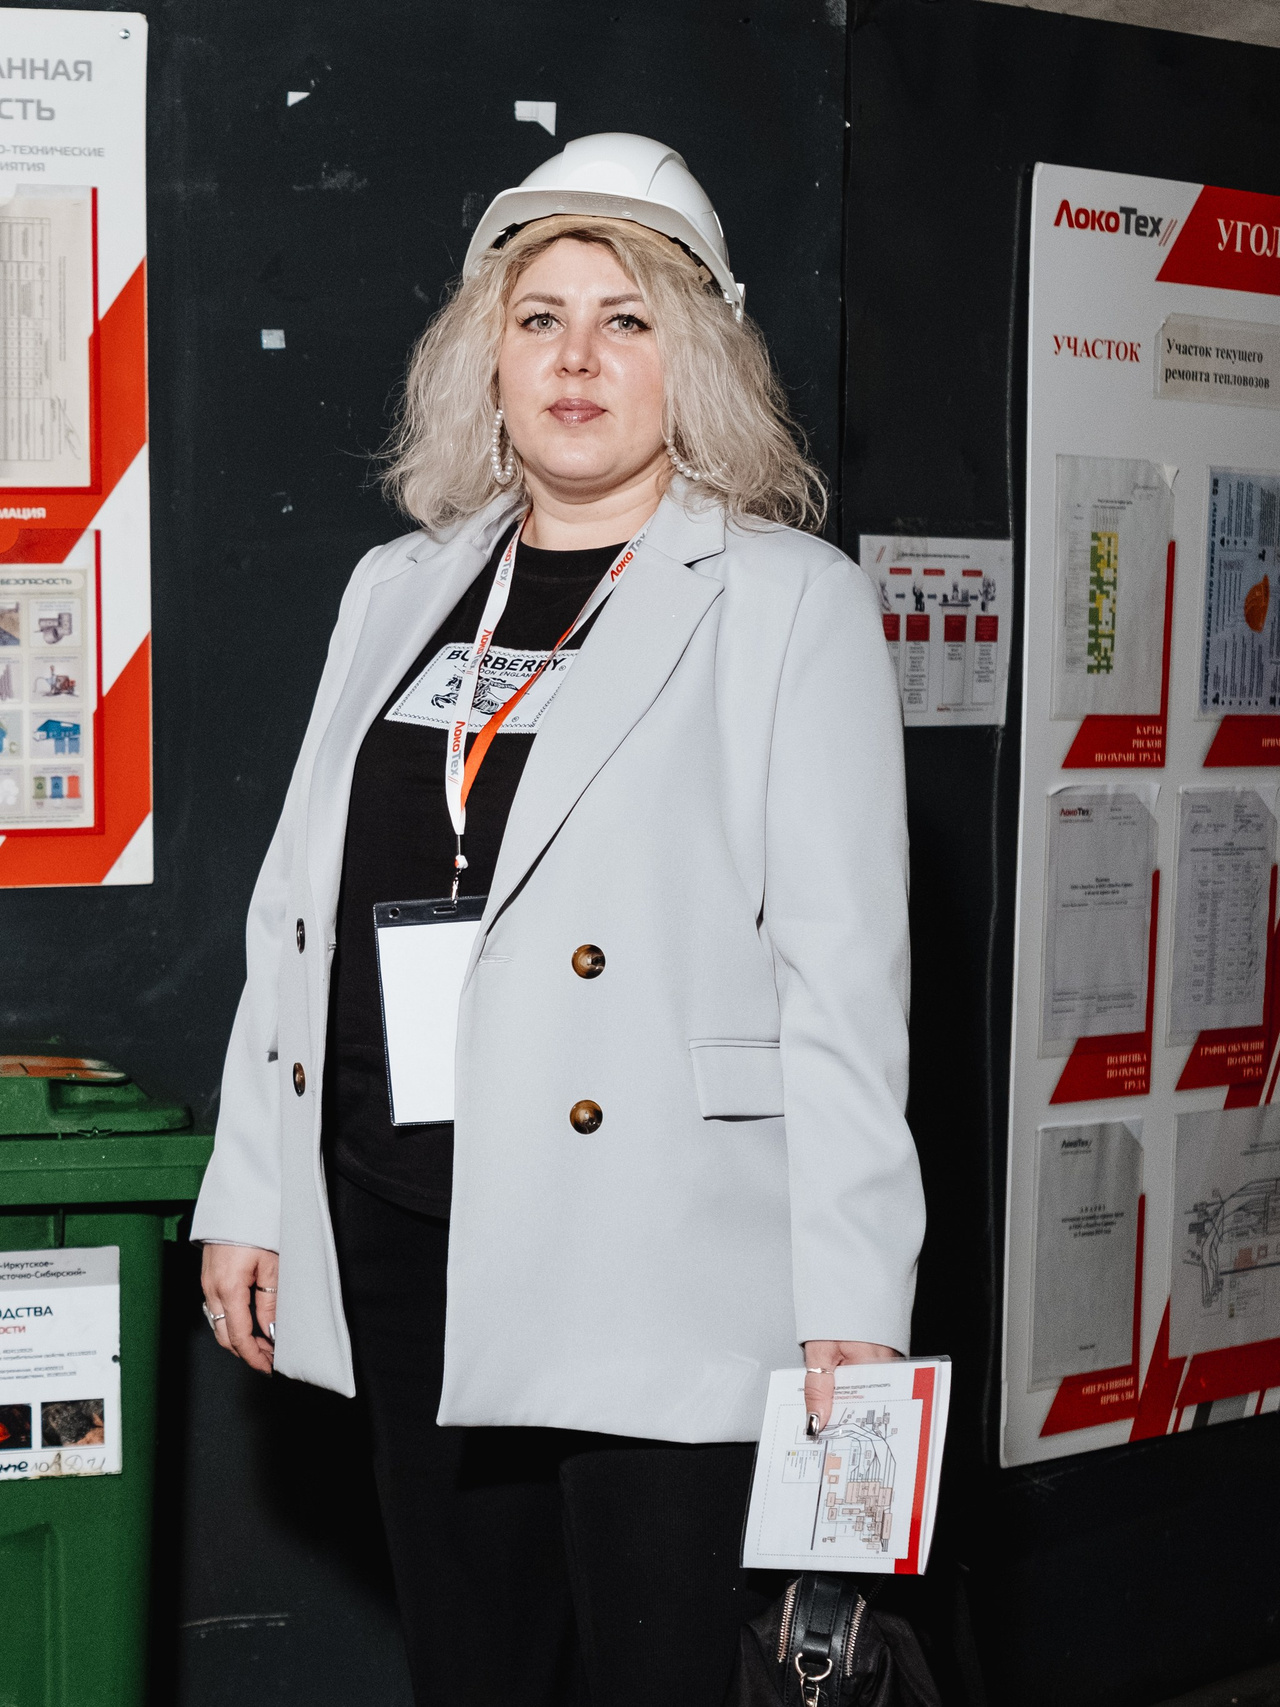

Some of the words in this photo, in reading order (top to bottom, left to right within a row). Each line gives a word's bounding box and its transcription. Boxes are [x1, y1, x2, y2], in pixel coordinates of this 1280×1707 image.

[1054, 199, 1163, 238] ЛокоТех
[1053, 335, 1141, 363] УЧАСТОК
[1166, 338, 1212, 358] Участок
[1215, 348, 1263, 364] текущего
[1165, 367, 1210, 383] ремонта
[1214, 374, 1270, 389] тепловозов
[1136, 726, 1163, 736] КАРТЫ
[450, 720, 466, 776] ЛокоТех
